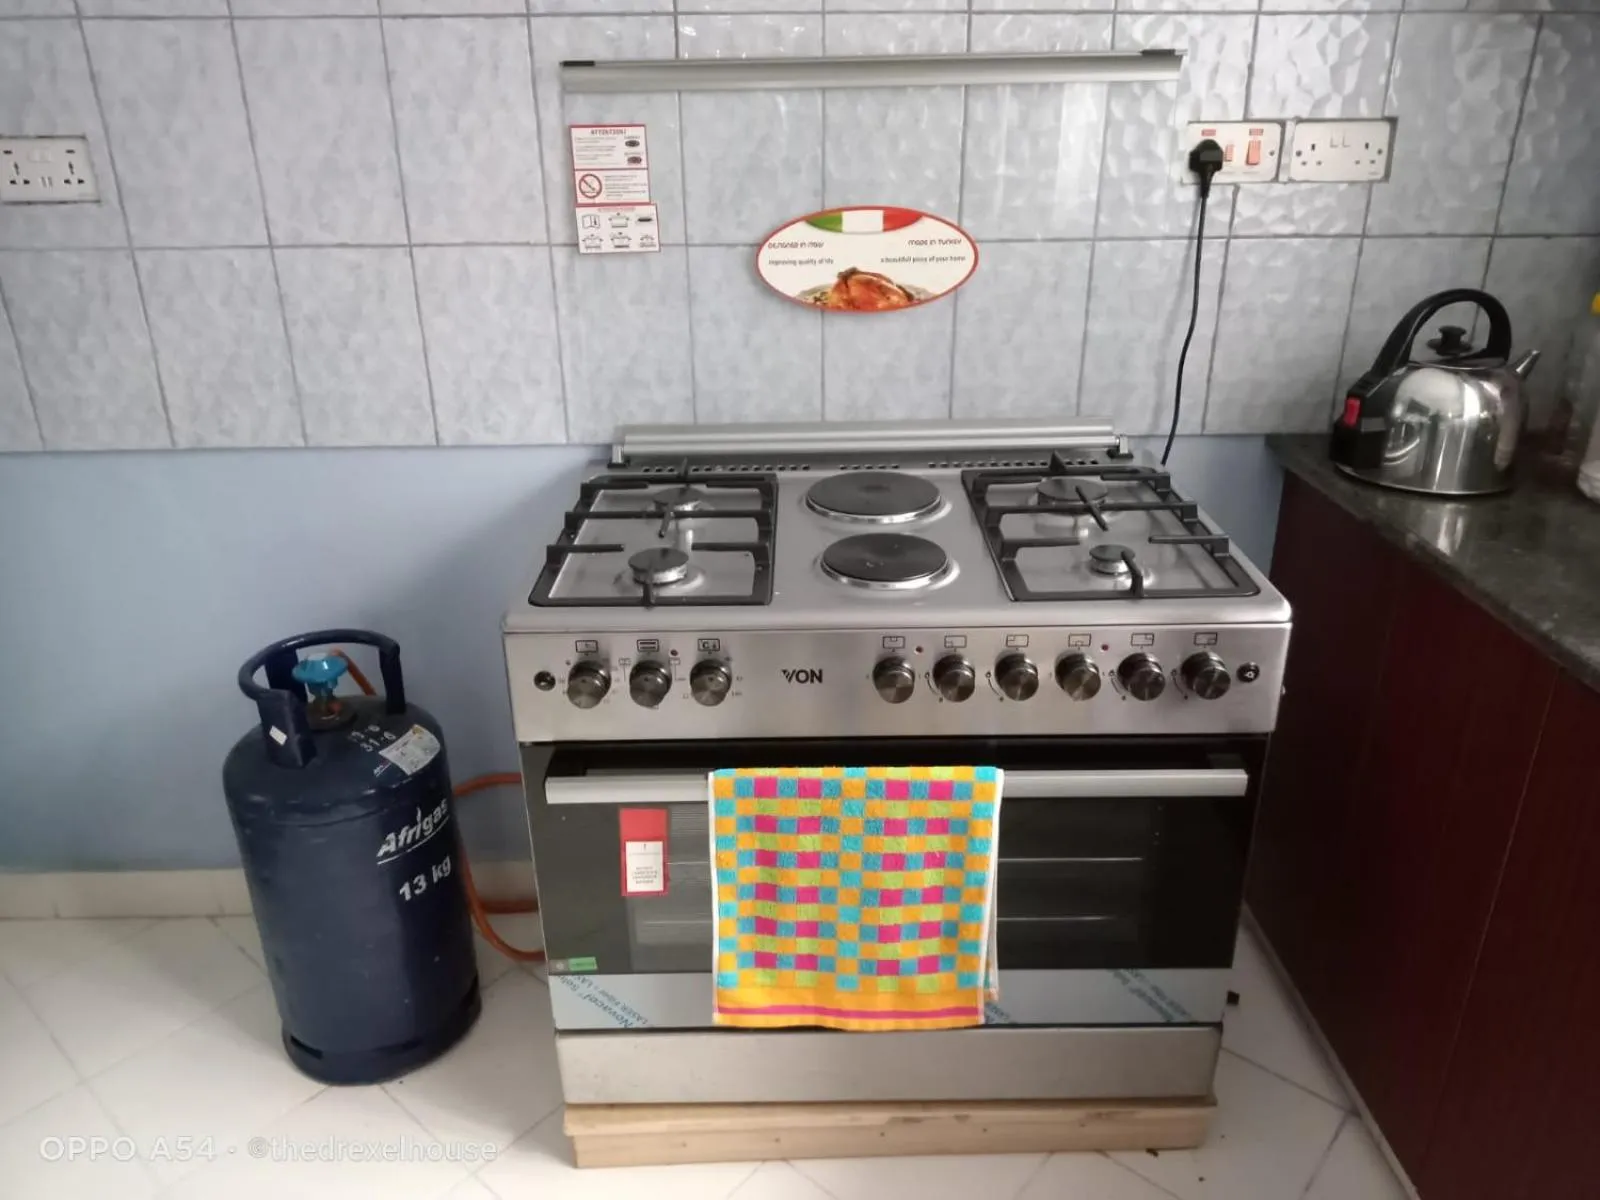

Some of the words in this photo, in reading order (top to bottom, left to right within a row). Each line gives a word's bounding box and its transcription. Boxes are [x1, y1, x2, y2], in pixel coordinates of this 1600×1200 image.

[781, 668, 823, 684] VON
[399, 873, 427, 901] 13
[431, 856, 452, 884] kg
